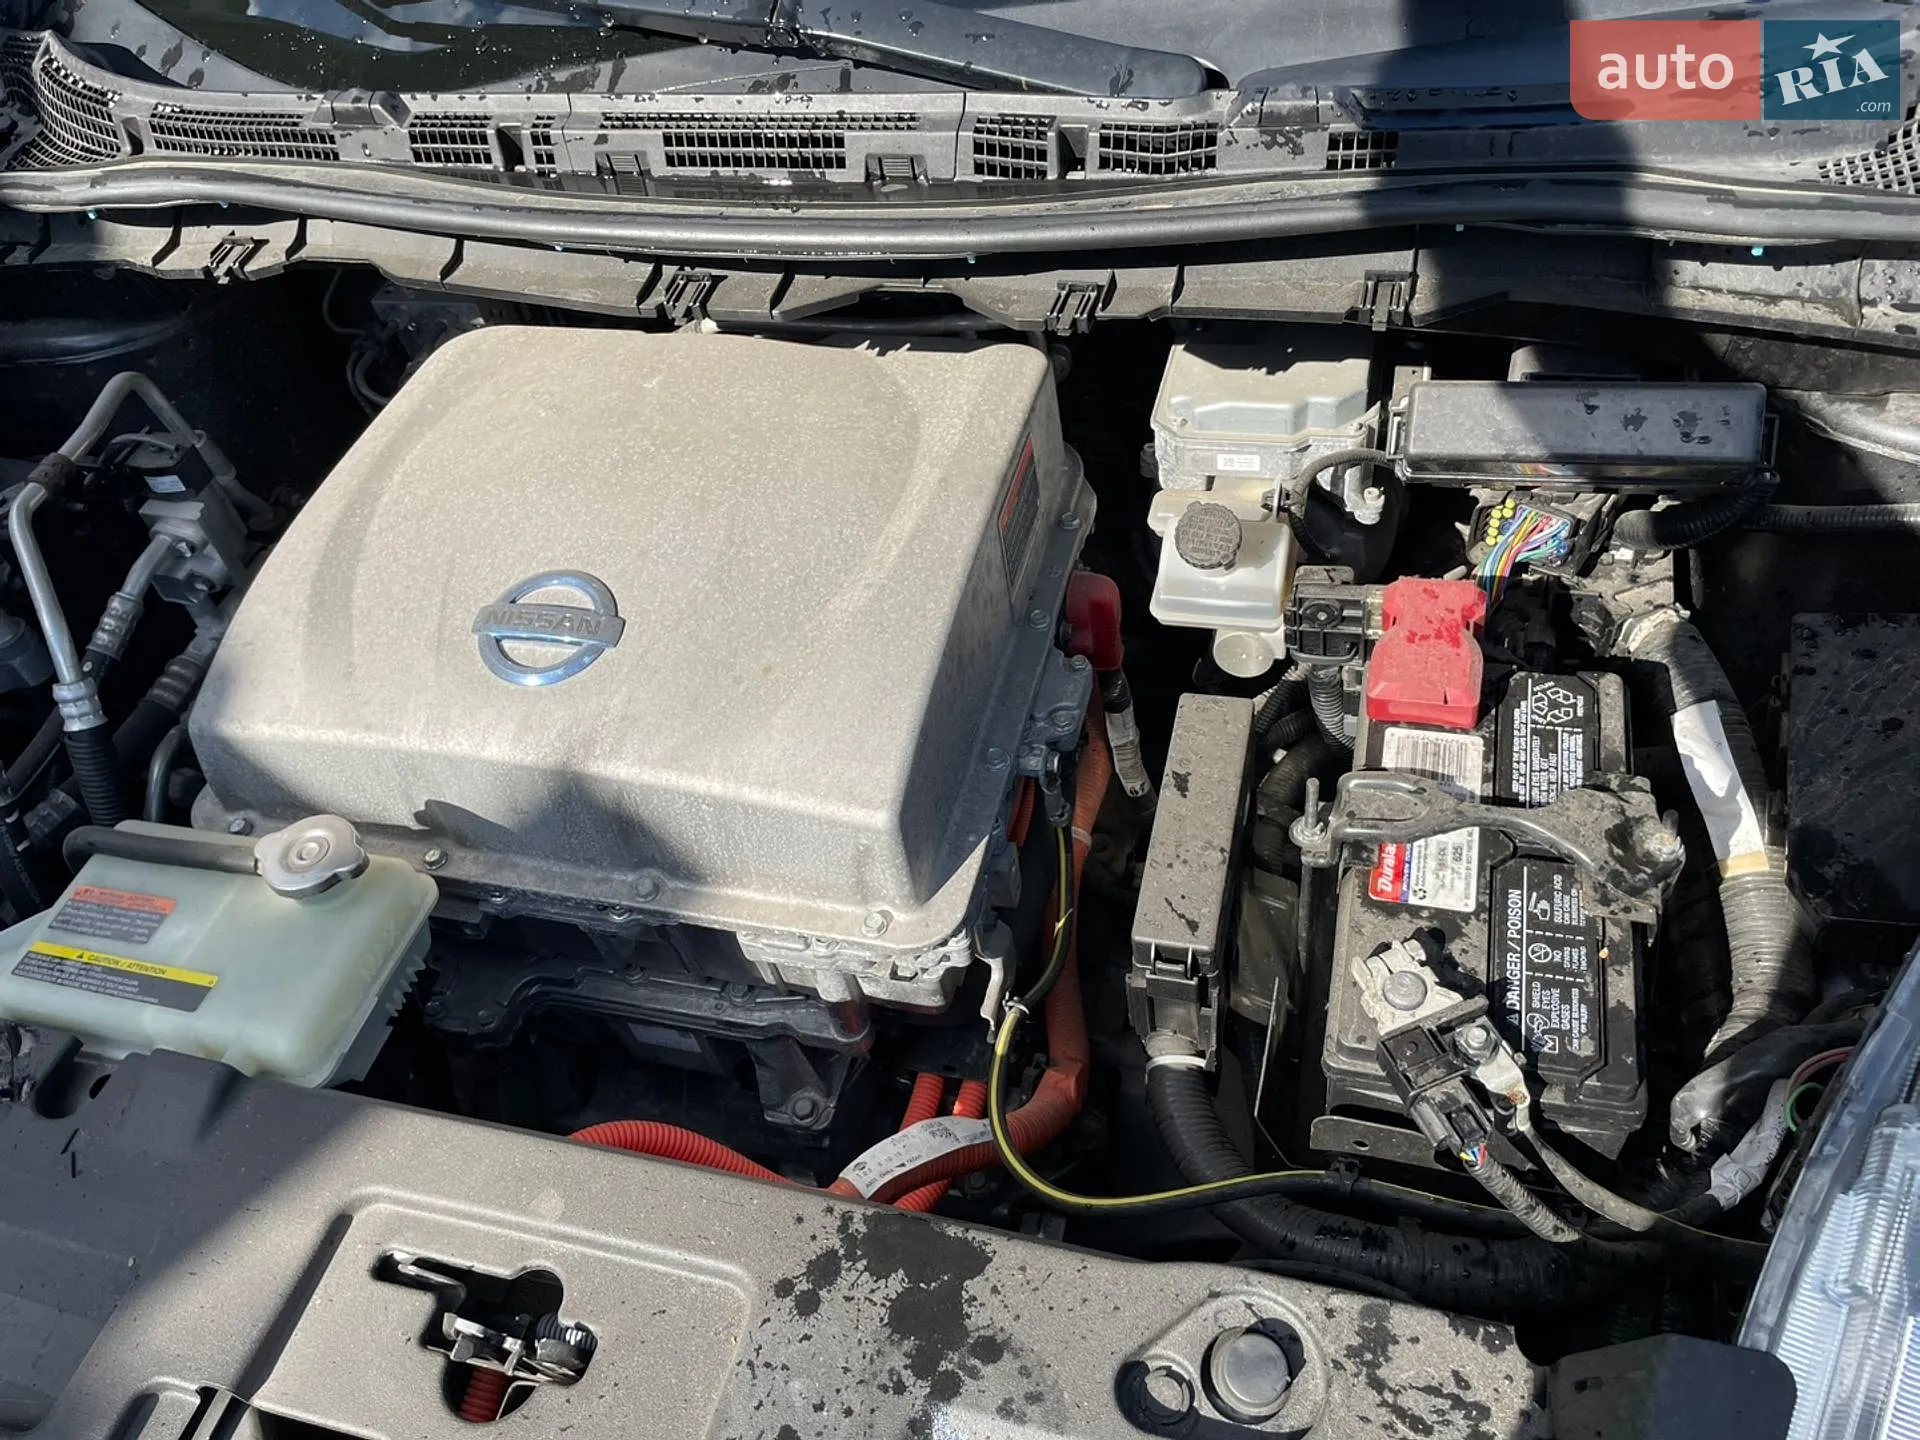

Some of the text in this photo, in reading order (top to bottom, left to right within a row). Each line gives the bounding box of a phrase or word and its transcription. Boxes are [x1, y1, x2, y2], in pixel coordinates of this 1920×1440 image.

[486, 609, 604, 636] NISSAN
[1453, 846, 1463, 862] 625
[1554, 892, 1562, 923] SULFURIC
[1506, 889, 1521, 1010] DANGER / POISON
[1554, 950, 1562, 962] NO
[126, 959, 167, 976] ATTENTION
[1532, 981, 1541, 1009] SHIELD
[1542, 989, 1550, 1009] EYES
[1550, 988, 1560, 1028] EXPLOSIVE
[1561, 1004, 1570, 1030] GASES
